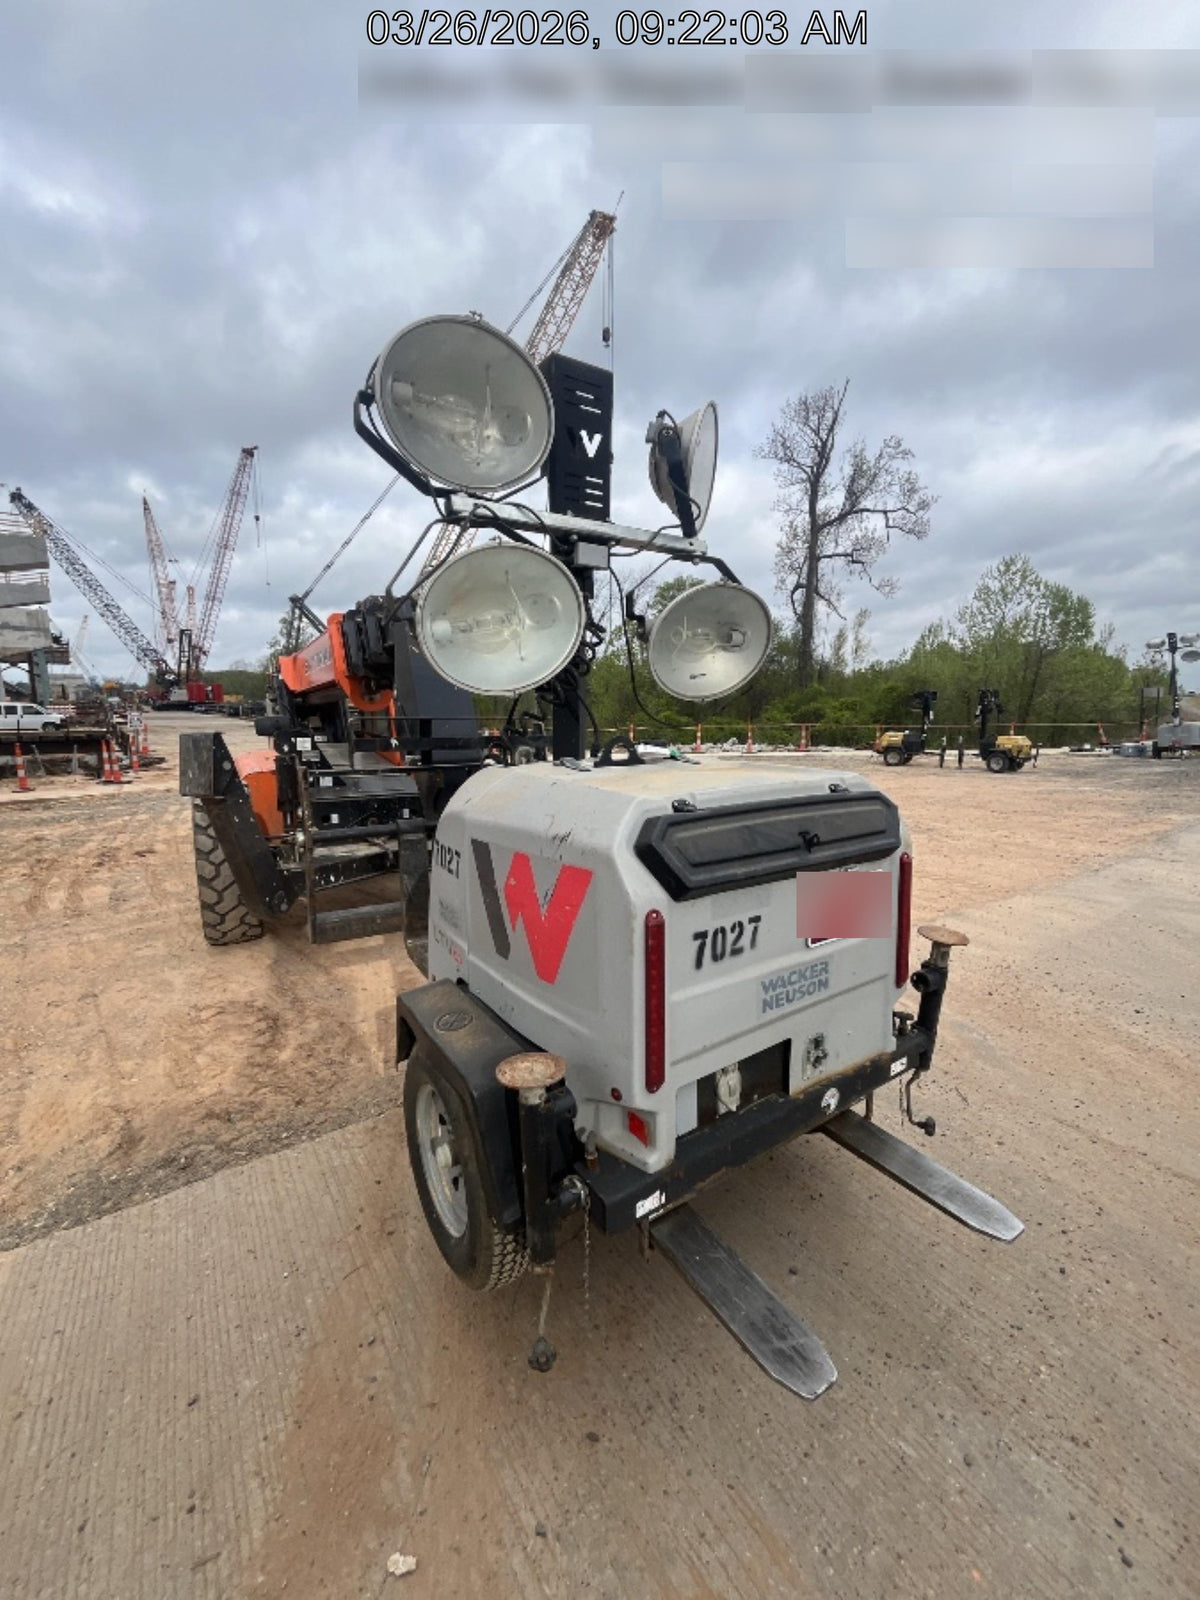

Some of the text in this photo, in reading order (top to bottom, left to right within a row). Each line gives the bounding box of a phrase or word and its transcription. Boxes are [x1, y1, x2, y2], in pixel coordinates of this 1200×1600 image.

[433, 839, 461, 879] 7027
[692, 915, 762, 970] 7027
[760, 961, 829, 995] WACKER
[762, 977, 829, 1013] NEUSON
